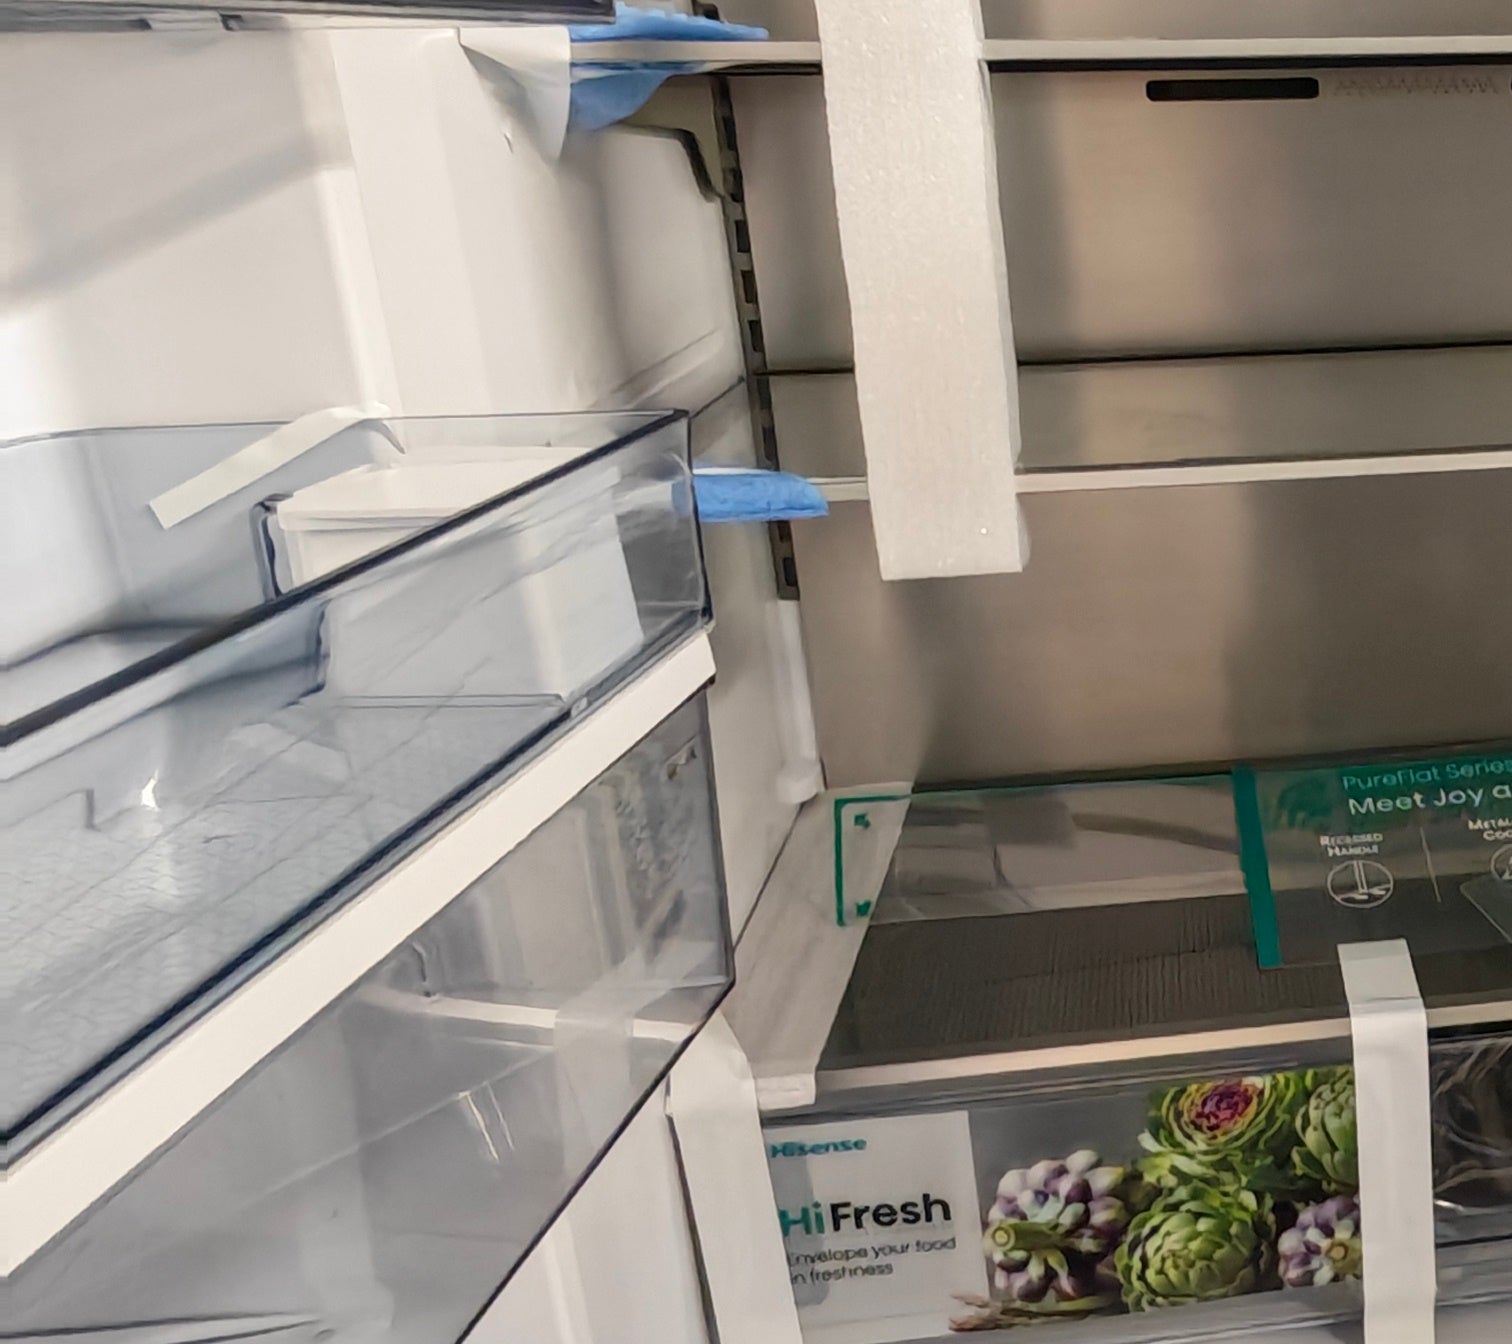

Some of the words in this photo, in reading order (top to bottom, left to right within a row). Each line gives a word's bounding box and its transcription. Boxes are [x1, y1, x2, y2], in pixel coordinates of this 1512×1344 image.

[1343, 766, 1441, 791] PureFlat
[1349, 791, 1426, 816] Meet
[1433, 787, 1484, 807] Joy
[770, 1138, 868, 1158] Hisense
[915, 1236, 957, 1253] food
